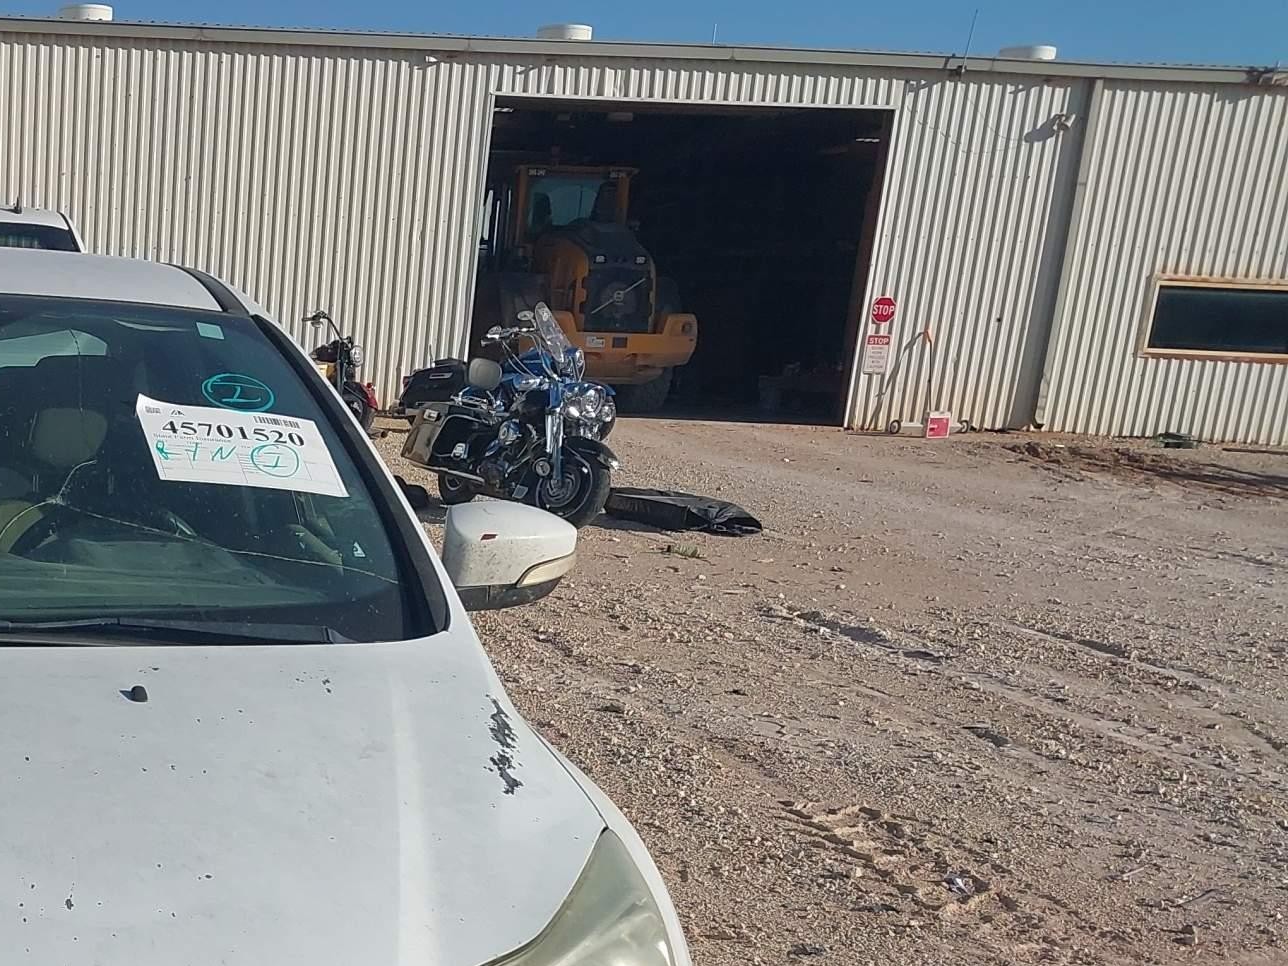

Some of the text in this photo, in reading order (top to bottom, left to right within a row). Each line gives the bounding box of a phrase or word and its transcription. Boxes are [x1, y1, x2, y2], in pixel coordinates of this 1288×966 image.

[872, 304, 895, 316] STOP
[868, 337, 889, 345] STOP
[161, 420, 305, 446] 45701520
